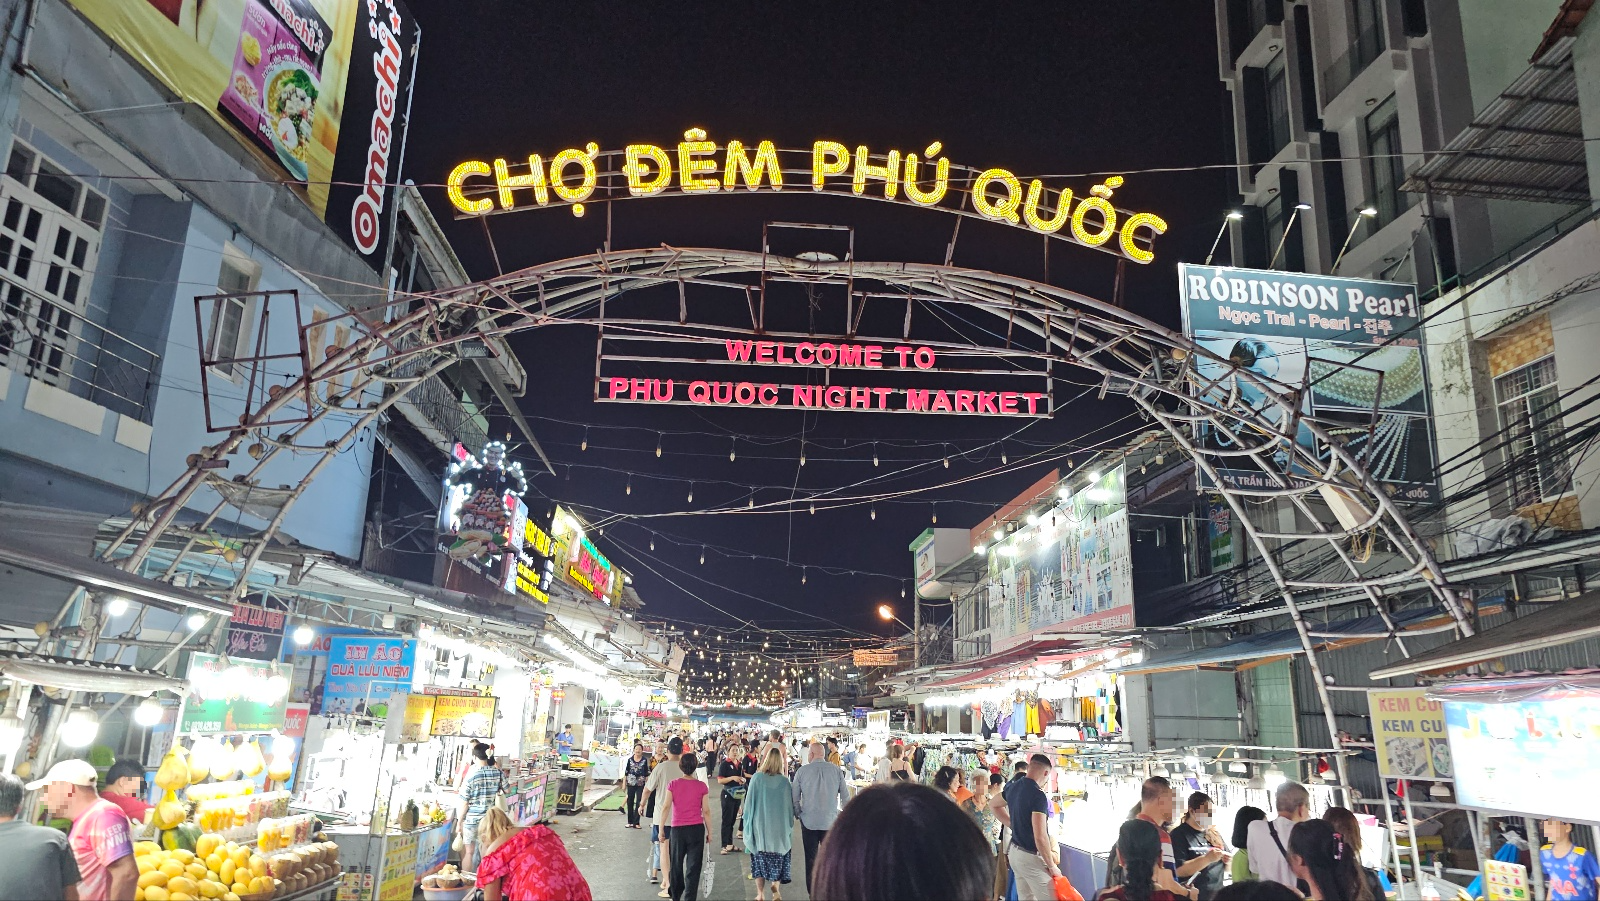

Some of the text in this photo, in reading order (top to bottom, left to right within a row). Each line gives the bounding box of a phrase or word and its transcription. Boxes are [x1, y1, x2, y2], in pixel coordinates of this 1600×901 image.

[352, 21, 402, 255] Omachi
[447, 128, 1168, 265] CHỢ ĐÊM PHÚ QUỐC
[1188, 274, 1417, 318] ROBINSON Pearl
[1218, 306, 1261, 325] Ngọc
[1263, 310, 1296, 327] Trai
[1308, 313, 1351, 331] Pearl
[725, 339, 936, 370] WELCOME TO
[609, 377, 1043, 416] PHU QUOC NIGHT MARKET
[345, 643, 403, 661] IN ÁO
[382, 664, 409, 680] NIỆM
[1378, 697, 1411, 712] KEM
[1381, 719, 1415, 732] KEM
